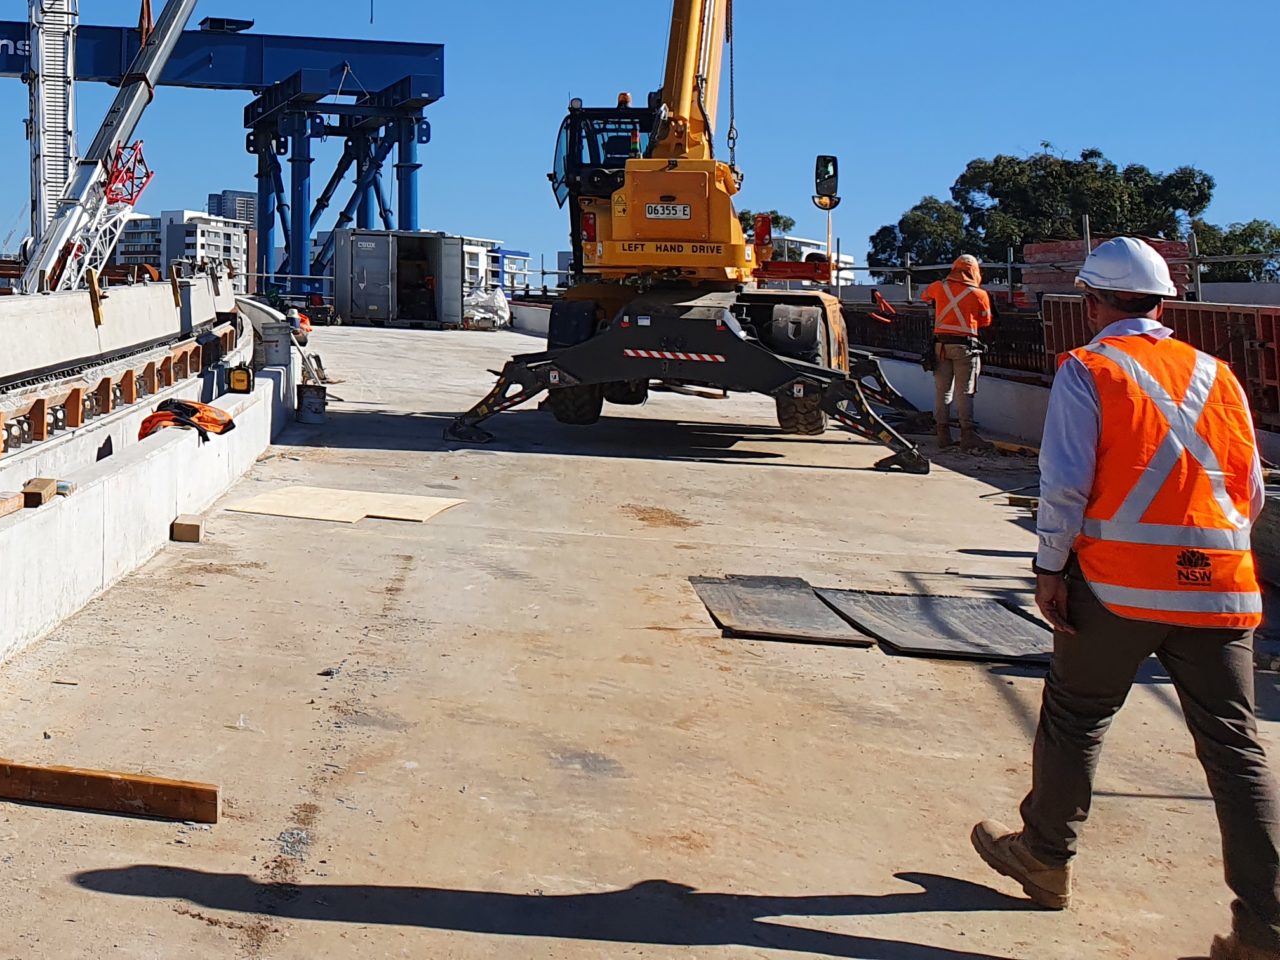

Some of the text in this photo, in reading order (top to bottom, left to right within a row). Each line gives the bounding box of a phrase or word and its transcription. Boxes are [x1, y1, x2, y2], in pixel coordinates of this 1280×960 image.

[622, 243, 723, 254] LEFT HAND DRIVE
[1177, 569, 1212, 582] NSW
